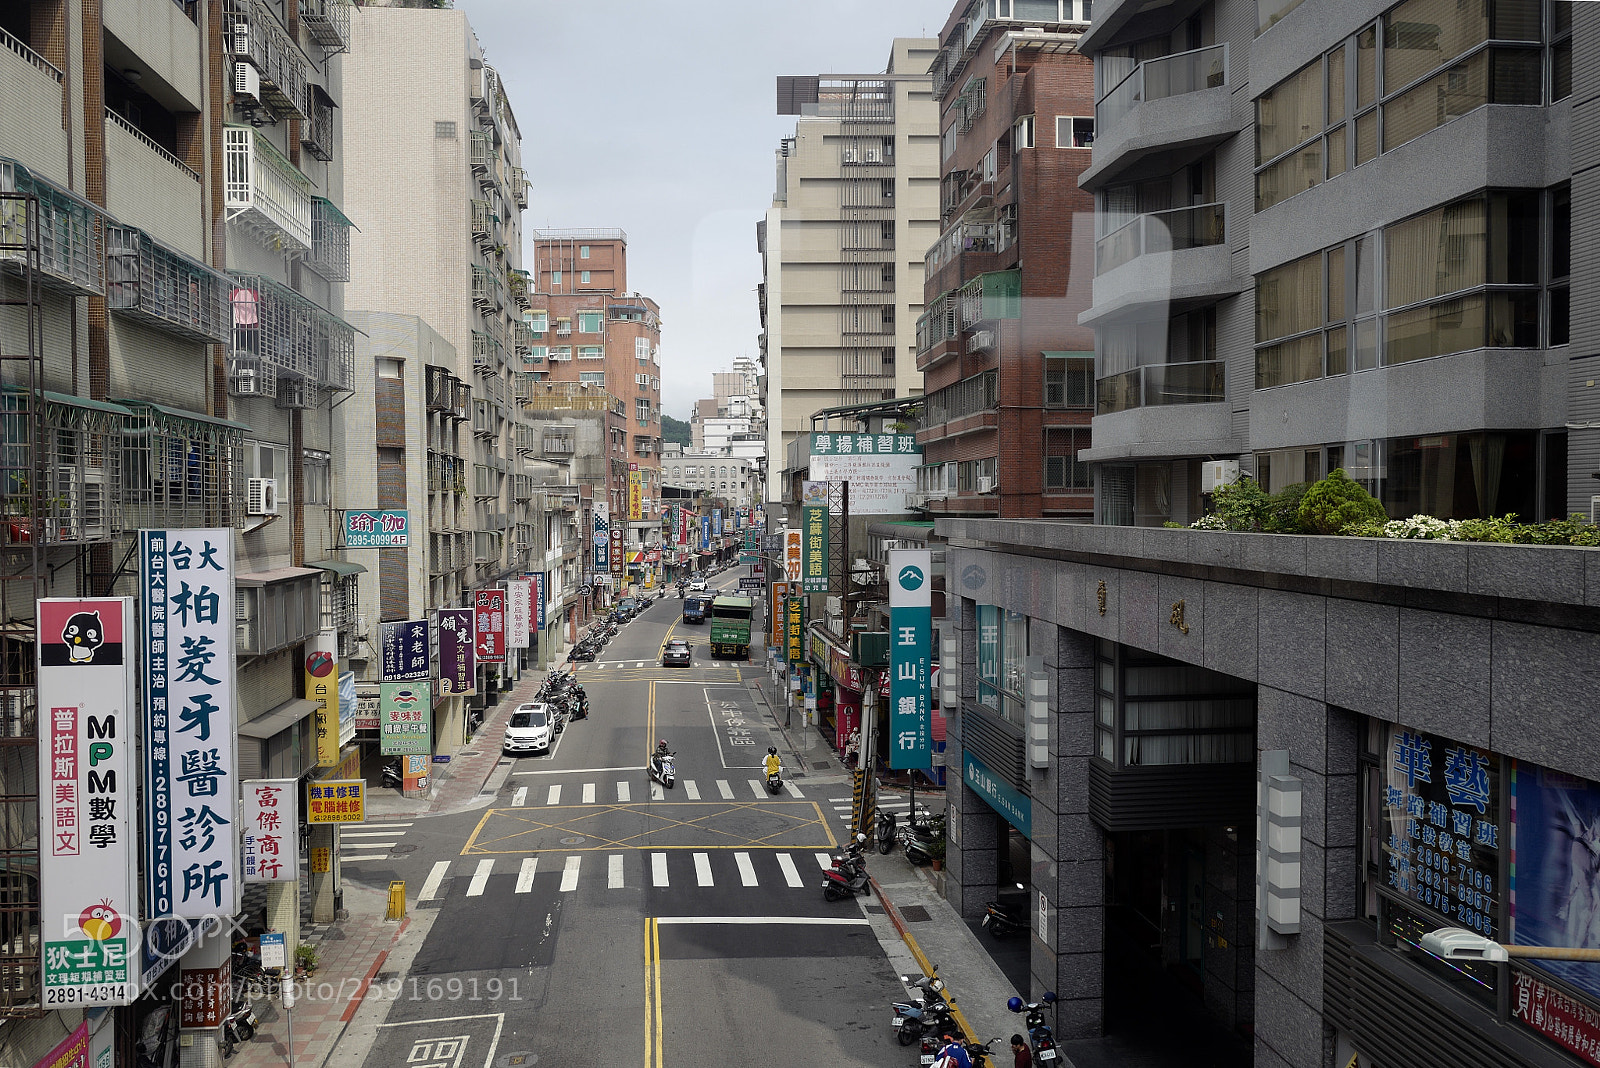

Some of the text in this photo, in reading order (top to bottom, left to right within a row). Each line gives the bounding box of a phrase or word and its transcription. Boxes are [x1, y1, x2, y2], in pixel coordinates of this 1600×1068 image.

[815, 435, 914, 453] 學揚補習班
[347, 534, 407, 545] 2895-6099 4F
[349, 513, 406, 533] 瑜伽
[150, 537, 166, 689] 前台大醫院醫師主治
[411, 625, 425, 668] 宋老師
[442, 680, 449, 694] 2F
[898, 626, 917, 750] 玉山銀行
[170, 580, 230, 907] 柏菱牙醫診所
[53, 710, 76, 852] 普拉斯美語文
[975, 768, 997, 799] 玉山銀行
[1393, 731, 1490, 814] 華藝
[310, 785, 361, 800] 機車修理
[310, 799, 361, 815] 電腦維修
[255, 786, 284, 879] 富傑商行
[1386, 784, 1499, 849] 舞蹈補習班
[245, 835, 256, 875] 手工饅頭
[1406, 818, 1472, 863] 北投教室
[47, 944, 125, 970] 狄士尼
[47, 969, 126, 984] 文理短期補習班
[47, 985, 125, 1004] 2891-4314
